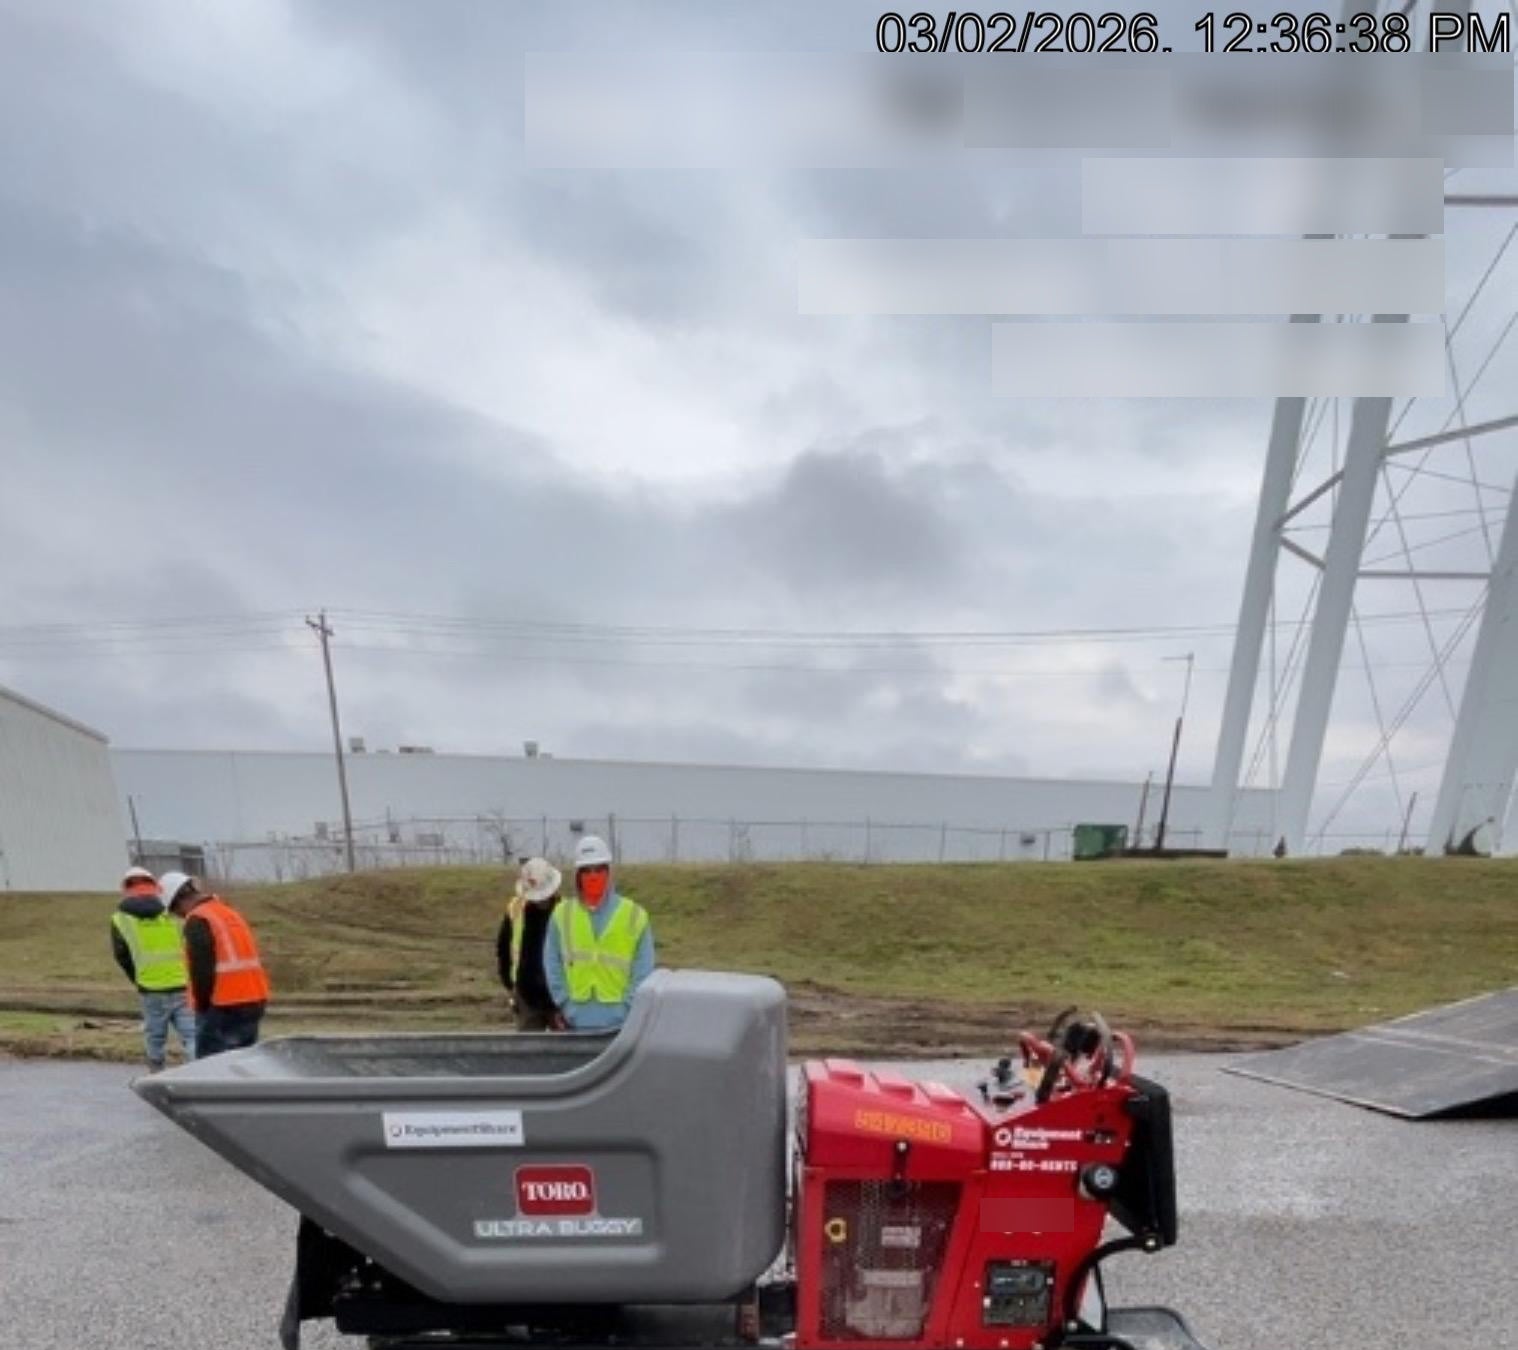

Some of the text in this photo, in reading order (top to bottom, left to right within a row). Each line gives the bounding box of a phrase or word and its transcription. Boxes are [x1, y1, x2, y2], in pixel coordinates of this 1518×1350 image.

[521, 1181, 588, 1201] TORO
[475, 1218, 637, 1237] ULTRA BUGGY
